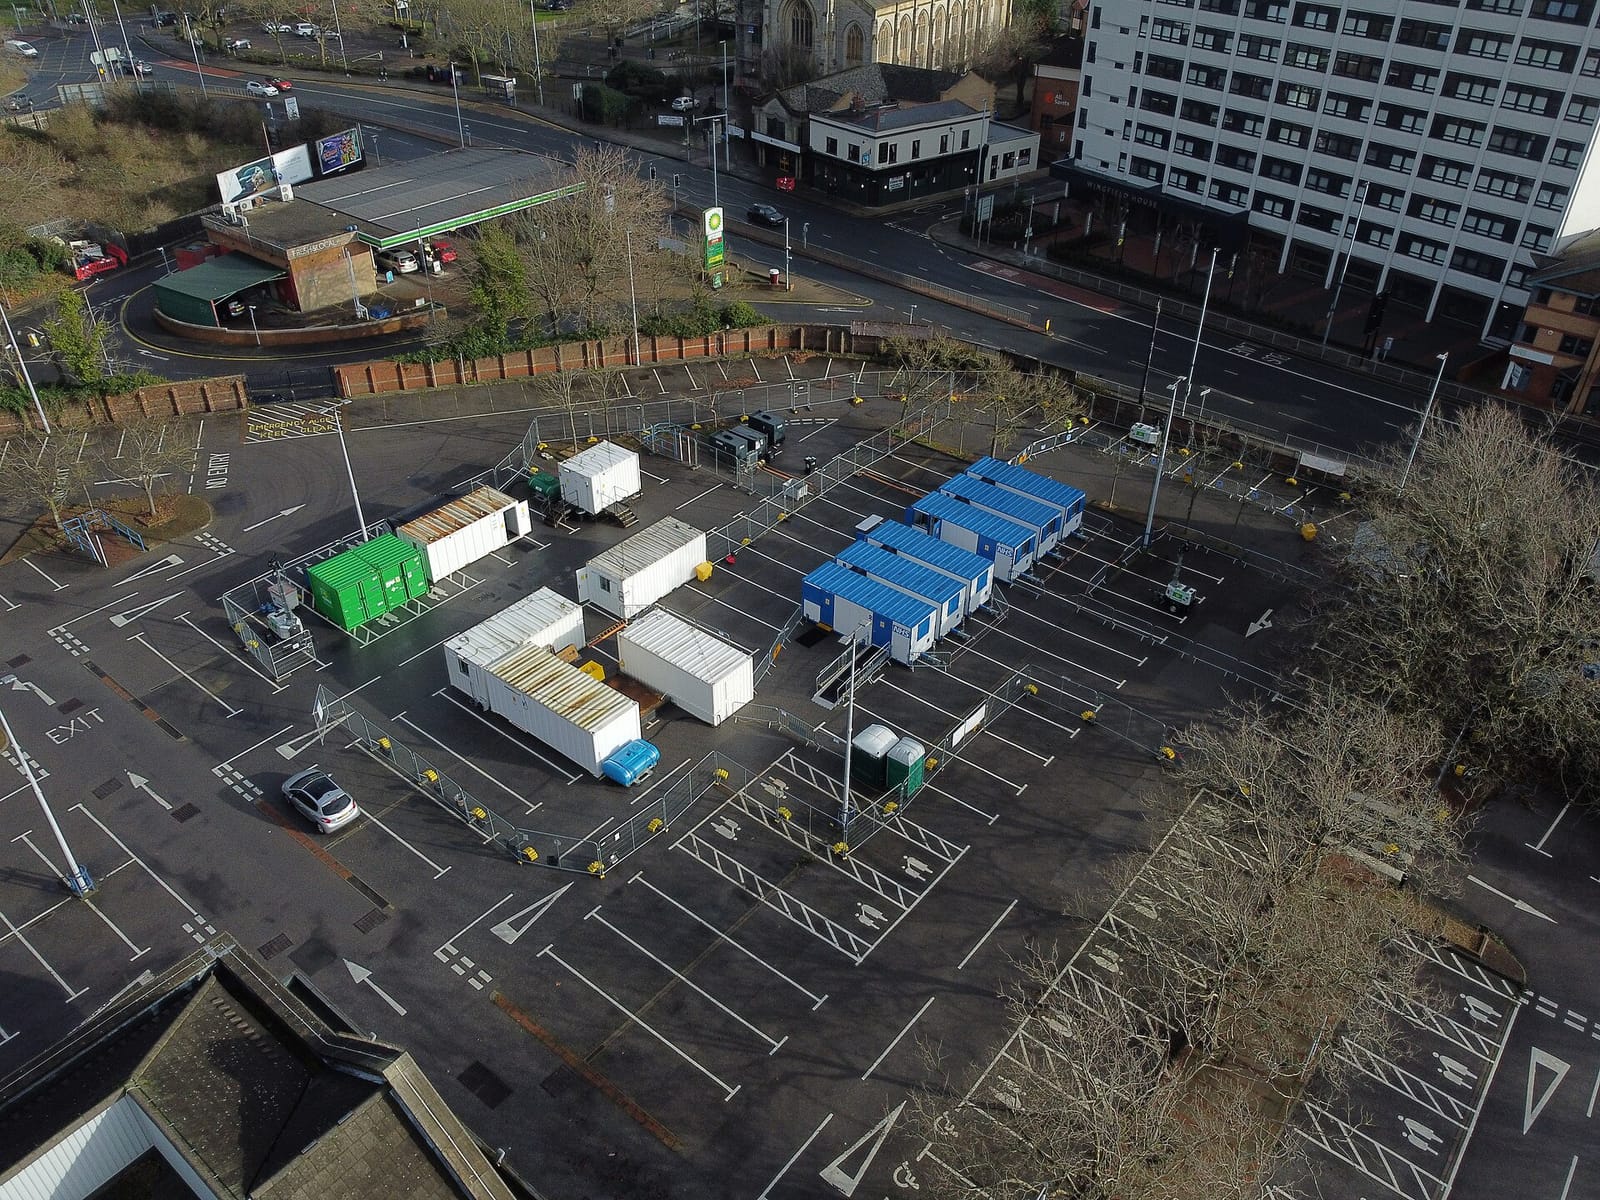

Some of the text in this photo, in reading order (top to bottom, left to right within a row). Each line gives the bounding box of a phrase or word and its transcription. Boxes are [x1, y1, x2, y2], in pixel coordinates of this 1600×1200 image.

[249, 420, 306, 432] EMERGENCY
[260, 424, 333, 438] KEEP CLEAR
[205, 453, 230, 489] NO ENTRY
[996, 545, 1013, 557] NHS
[893, 625, 911, 639] NHS
[45, 708, 104, 744] EXIT
